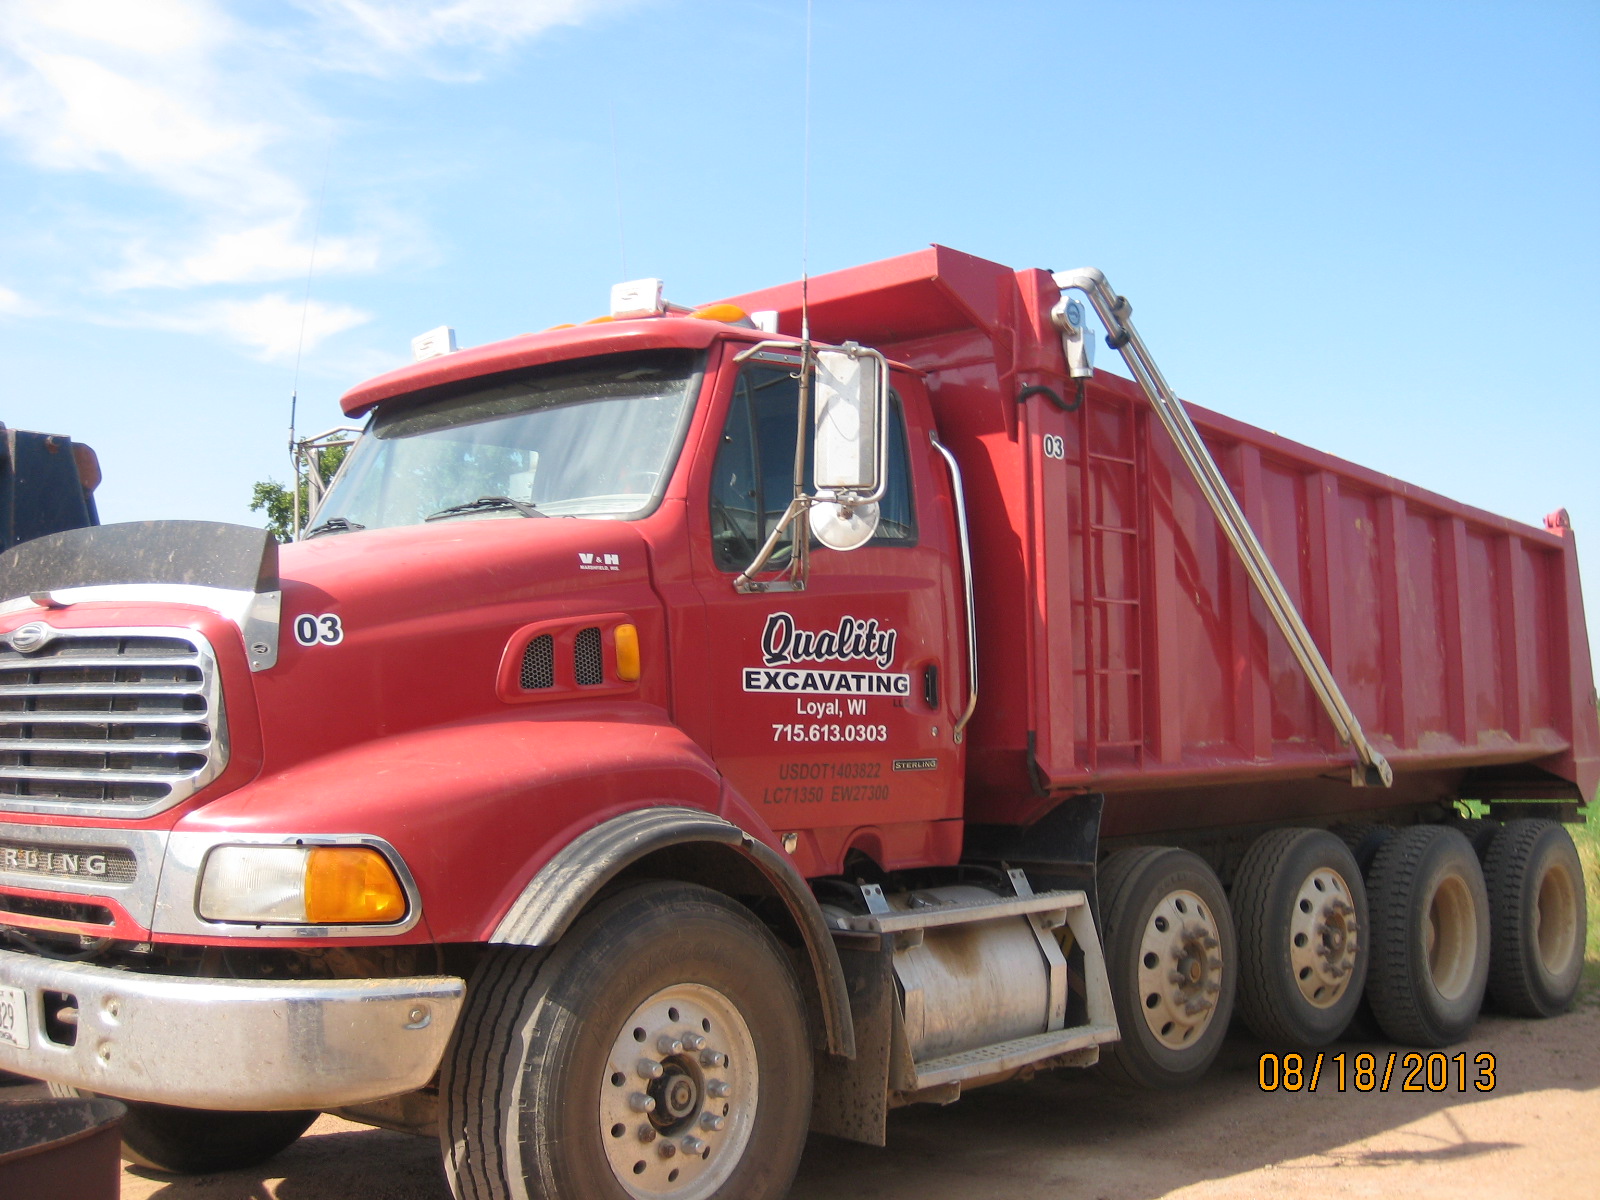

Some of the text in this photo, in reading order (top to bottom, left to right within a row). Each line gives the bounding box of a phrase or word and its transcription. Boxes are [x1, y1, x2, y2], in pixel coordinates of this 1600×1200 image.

[1044, 434, 1065, 460] 03
[578, 552, 594, 564] V
[603, 553, 619, 565] H
[294, 613, 344, 647] 03
[761, 612, 897, 670] Quality
[744, 670, 909, 694] EXCAVATING
[797, 698, 867, 719] Loyal, WI
[772, 723, 888, 742] 715.613.0303
[779, 763, 881, 780] USDOT1403822
[895, 760, 936, 769] STERLING
[763, 785, 890, 805] LC71350 EW27300
